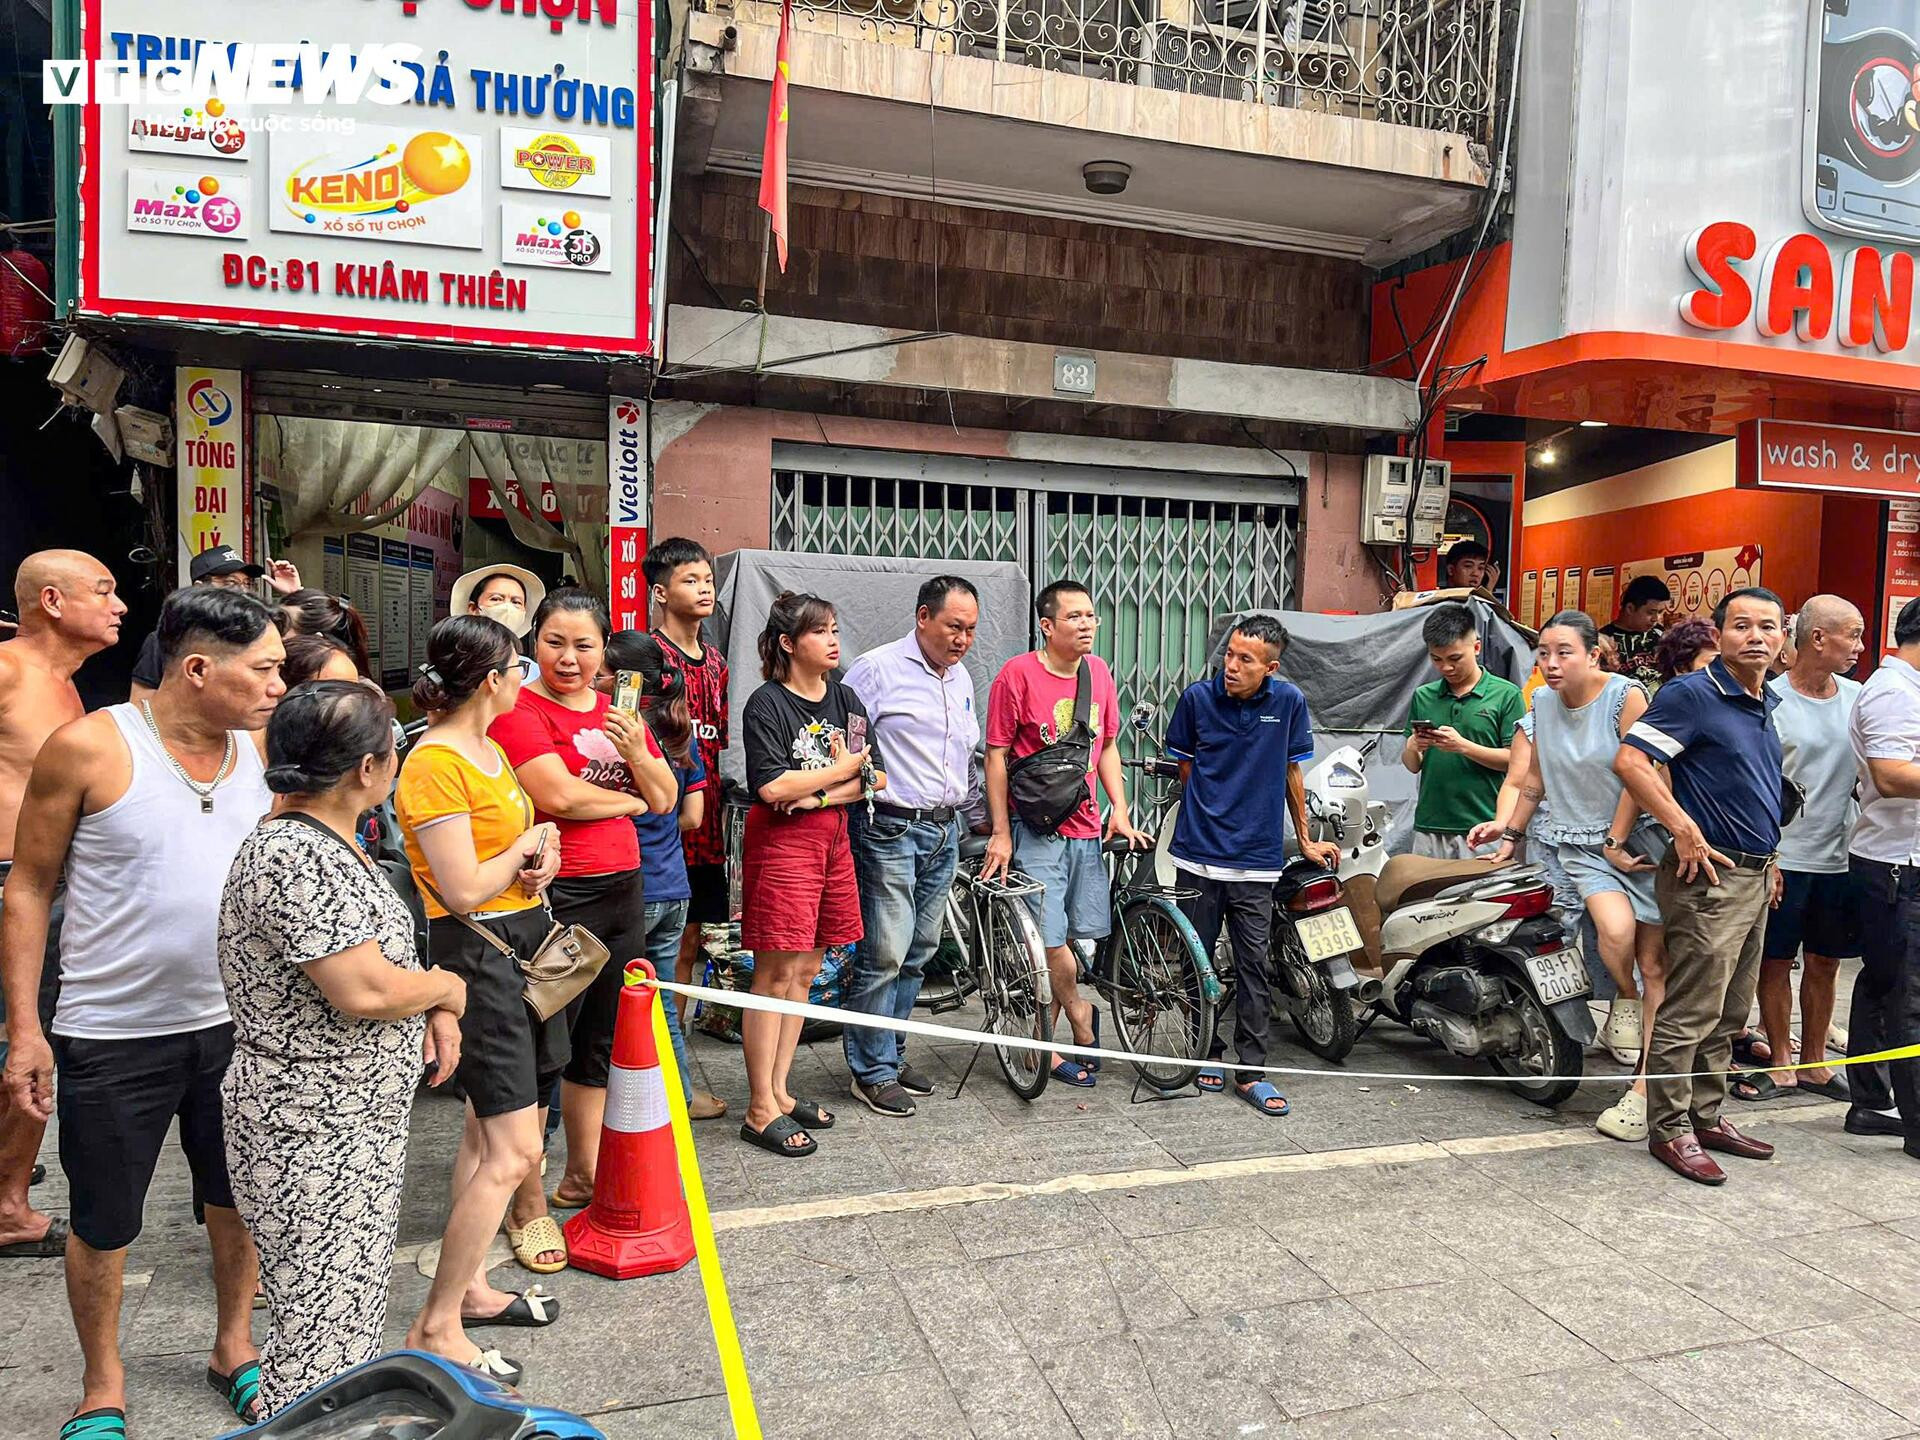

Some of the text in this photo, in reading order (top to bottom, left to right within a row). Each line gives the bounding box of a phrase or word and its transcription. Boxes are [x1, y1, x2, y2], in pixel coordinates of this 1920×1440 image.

[470, 63, 635, 128] THƯỞNG
[517, 150, 593, 171] POWER
[292, 164, 400, 204] KENO
[133, 199, 199, 219] Max
[323, 216, 426, 234] XỔ SỐ TỰ CHỌN
[515, 233, 562, 249] Max
[570, 253, 591, 263] PRO
[335, 260, 429, 302] KHÂM
[439, 270, 527, 311] THIÊN
[1681, 221, 1915, 353] SAN
[1063, 363, 1088, 386] 83
[185, 430, 235, 469] TỔNG
[1766, 440, 1838, 469] wash
[1852, 442, 1871, 472] &
[618, 428, 638, 522] Vietlott
[195, 486, 227, 519] ĐẠI
[621, 532, 637, 563] XỔ
[621, 569, 637, 599] SỐ
[1305, 912, 1347, 938] 29-X9
[1311, 930, 1354, 957] 3396
[1536, 952, 1579, 978] 99-F1
